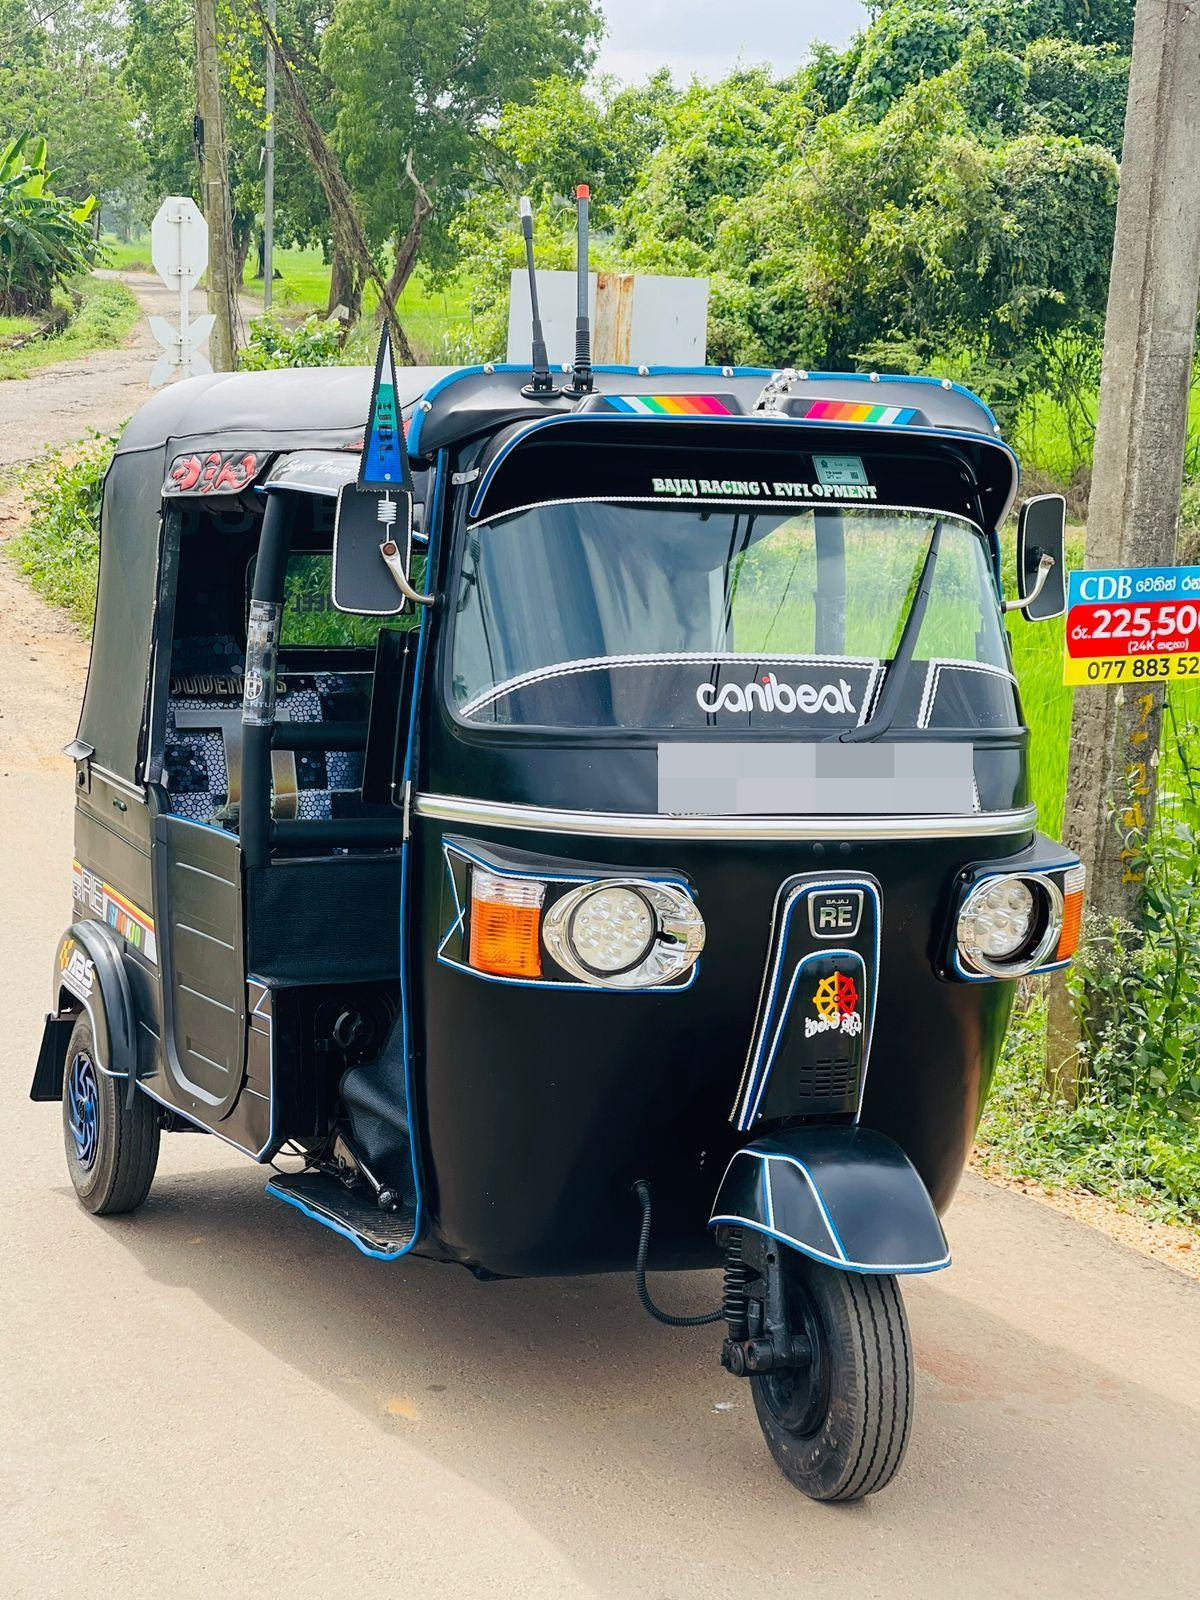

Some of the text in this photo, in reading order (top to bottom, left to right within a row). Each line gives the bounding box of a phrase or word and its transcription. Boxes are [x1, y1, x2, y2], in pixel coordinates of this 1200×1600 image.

[651, 478, 698, 496] BAJAJ
[698, 479, 760, 496] RACING
[1080, 575, 1133, 600] CDB
[1127, 640, 1155, 654] (24K
[1087, 660, 1126, 679] 077
[1132, 658, 1170, 677] 883
[696, 672, 857, 713] canibeat
[819, 906, 853, 928] RE
